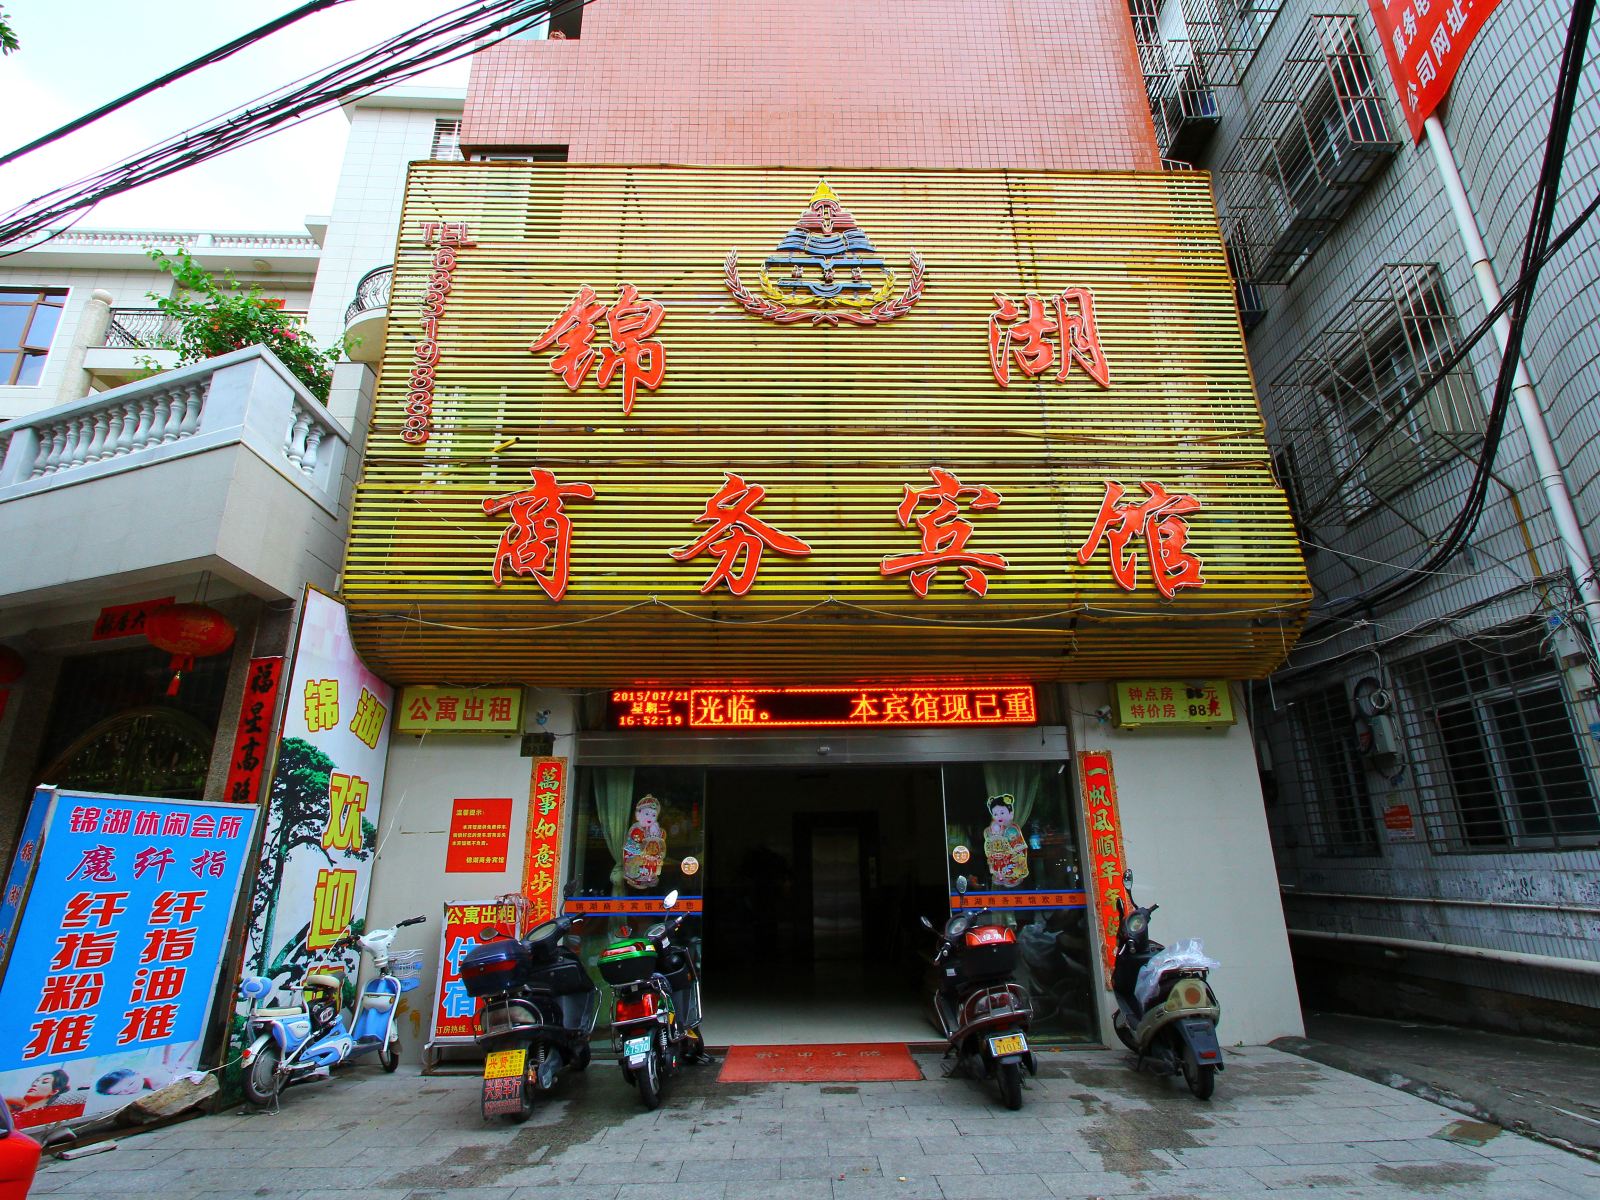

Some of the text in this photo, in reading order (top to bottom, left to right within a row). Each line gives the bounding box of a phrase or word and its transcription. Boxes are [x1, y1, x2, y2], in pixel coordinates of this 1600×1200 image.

[418, 221, 477, 247] TEL
[482, 466, 1206, 601] 商务宾馆
[613, 690, 689, 702] 2015/07/21
[1127, 686, 1174, 701] 钟点房
[304, 679, 388, 749] 锦湖
[407, 695, 513, 723] 公寓出租
[619, 715, 682, 726] 16:52:19
[630, 702, 672, 714] 星期二
[1130, 703, 1178, 719] 特价房
[68, 806, 244, 840] 锦湖休闲会所
[66, 844, 227, 883] 魔纤指
[446, 905, 516, 925] 公寓出租
[23, 891, 130, 1060] 纤指粉推
[116, 890, 208, 1045] 纤指油推
